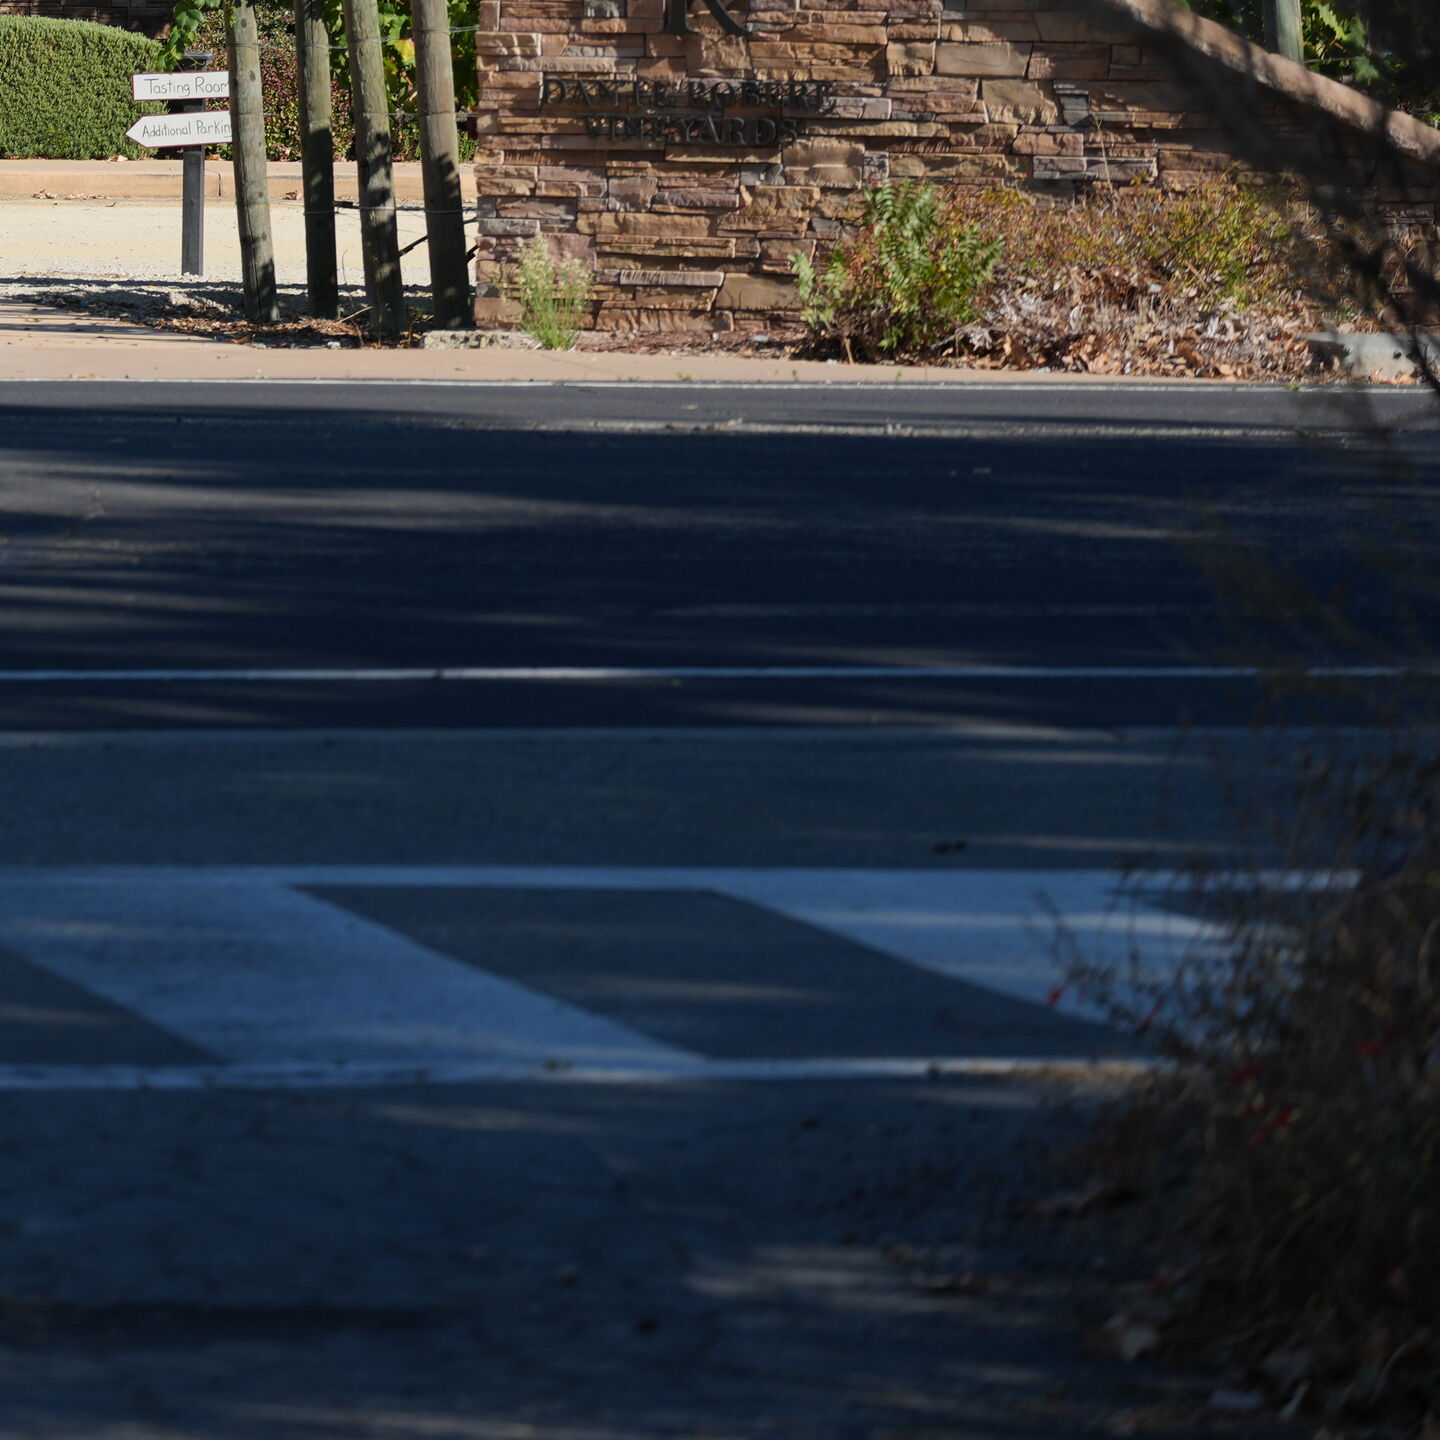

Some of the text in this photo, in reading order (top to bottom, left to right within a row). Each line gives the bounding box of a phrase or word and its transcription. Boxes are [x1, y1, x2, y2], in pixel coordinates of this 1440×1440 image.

[144, 78, 190, 97] Tasting
[141, 120, 232, 138] Additional Parkin
[584, 114, 799, 145] VINEYARDS
